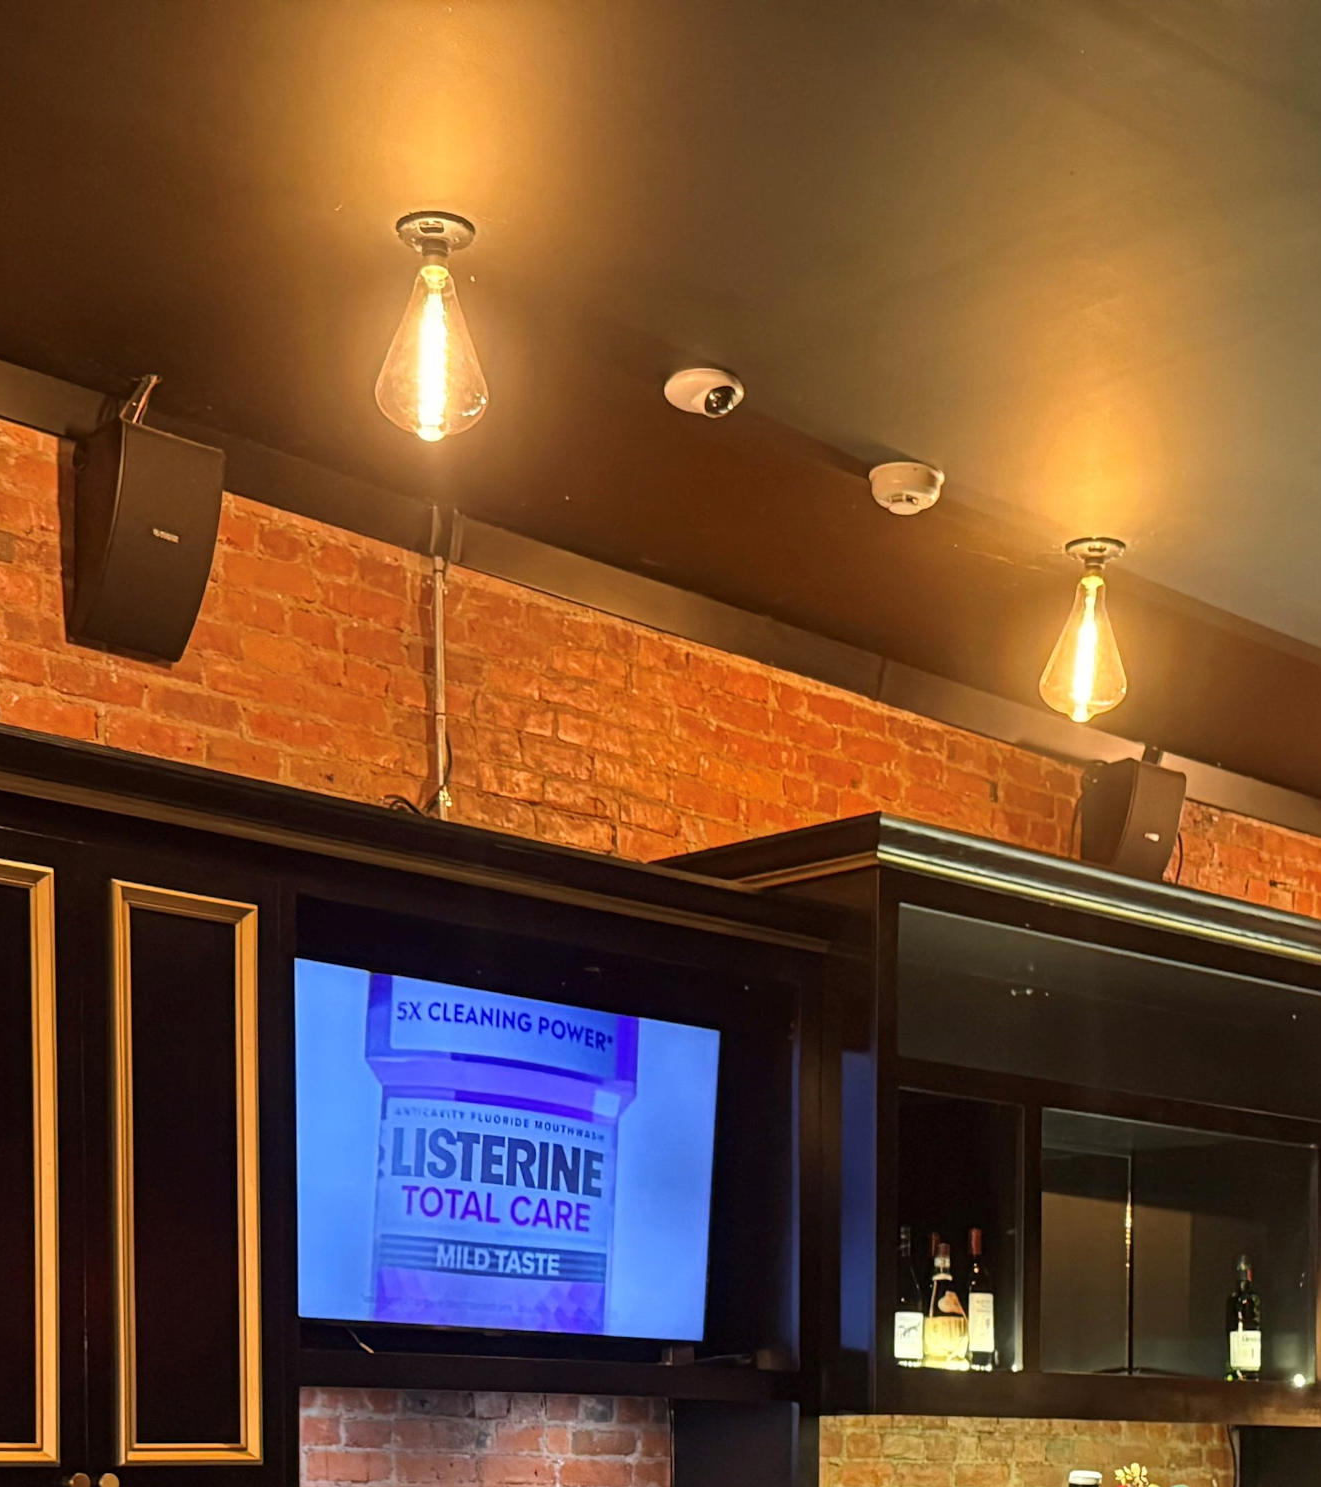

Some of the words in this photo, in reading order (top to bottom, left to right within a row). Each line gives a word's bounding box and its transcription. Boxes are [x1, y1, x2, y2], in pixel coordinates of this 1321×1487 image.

[396, 1001, 422, 1021] 5X
[428, 1002, 532, 1033] CLEANING
[470, 1110, 529, 1128] FLUORIDE
[390, 1127, 604, 1198] LISTERINE
[401, 1184, 501, 1224] TOTAL
[509, 1195, 591, 1233] CARE
[436, 1245, 491, 1270] MILD
[492, 1250, 561, 1276] TASTE
